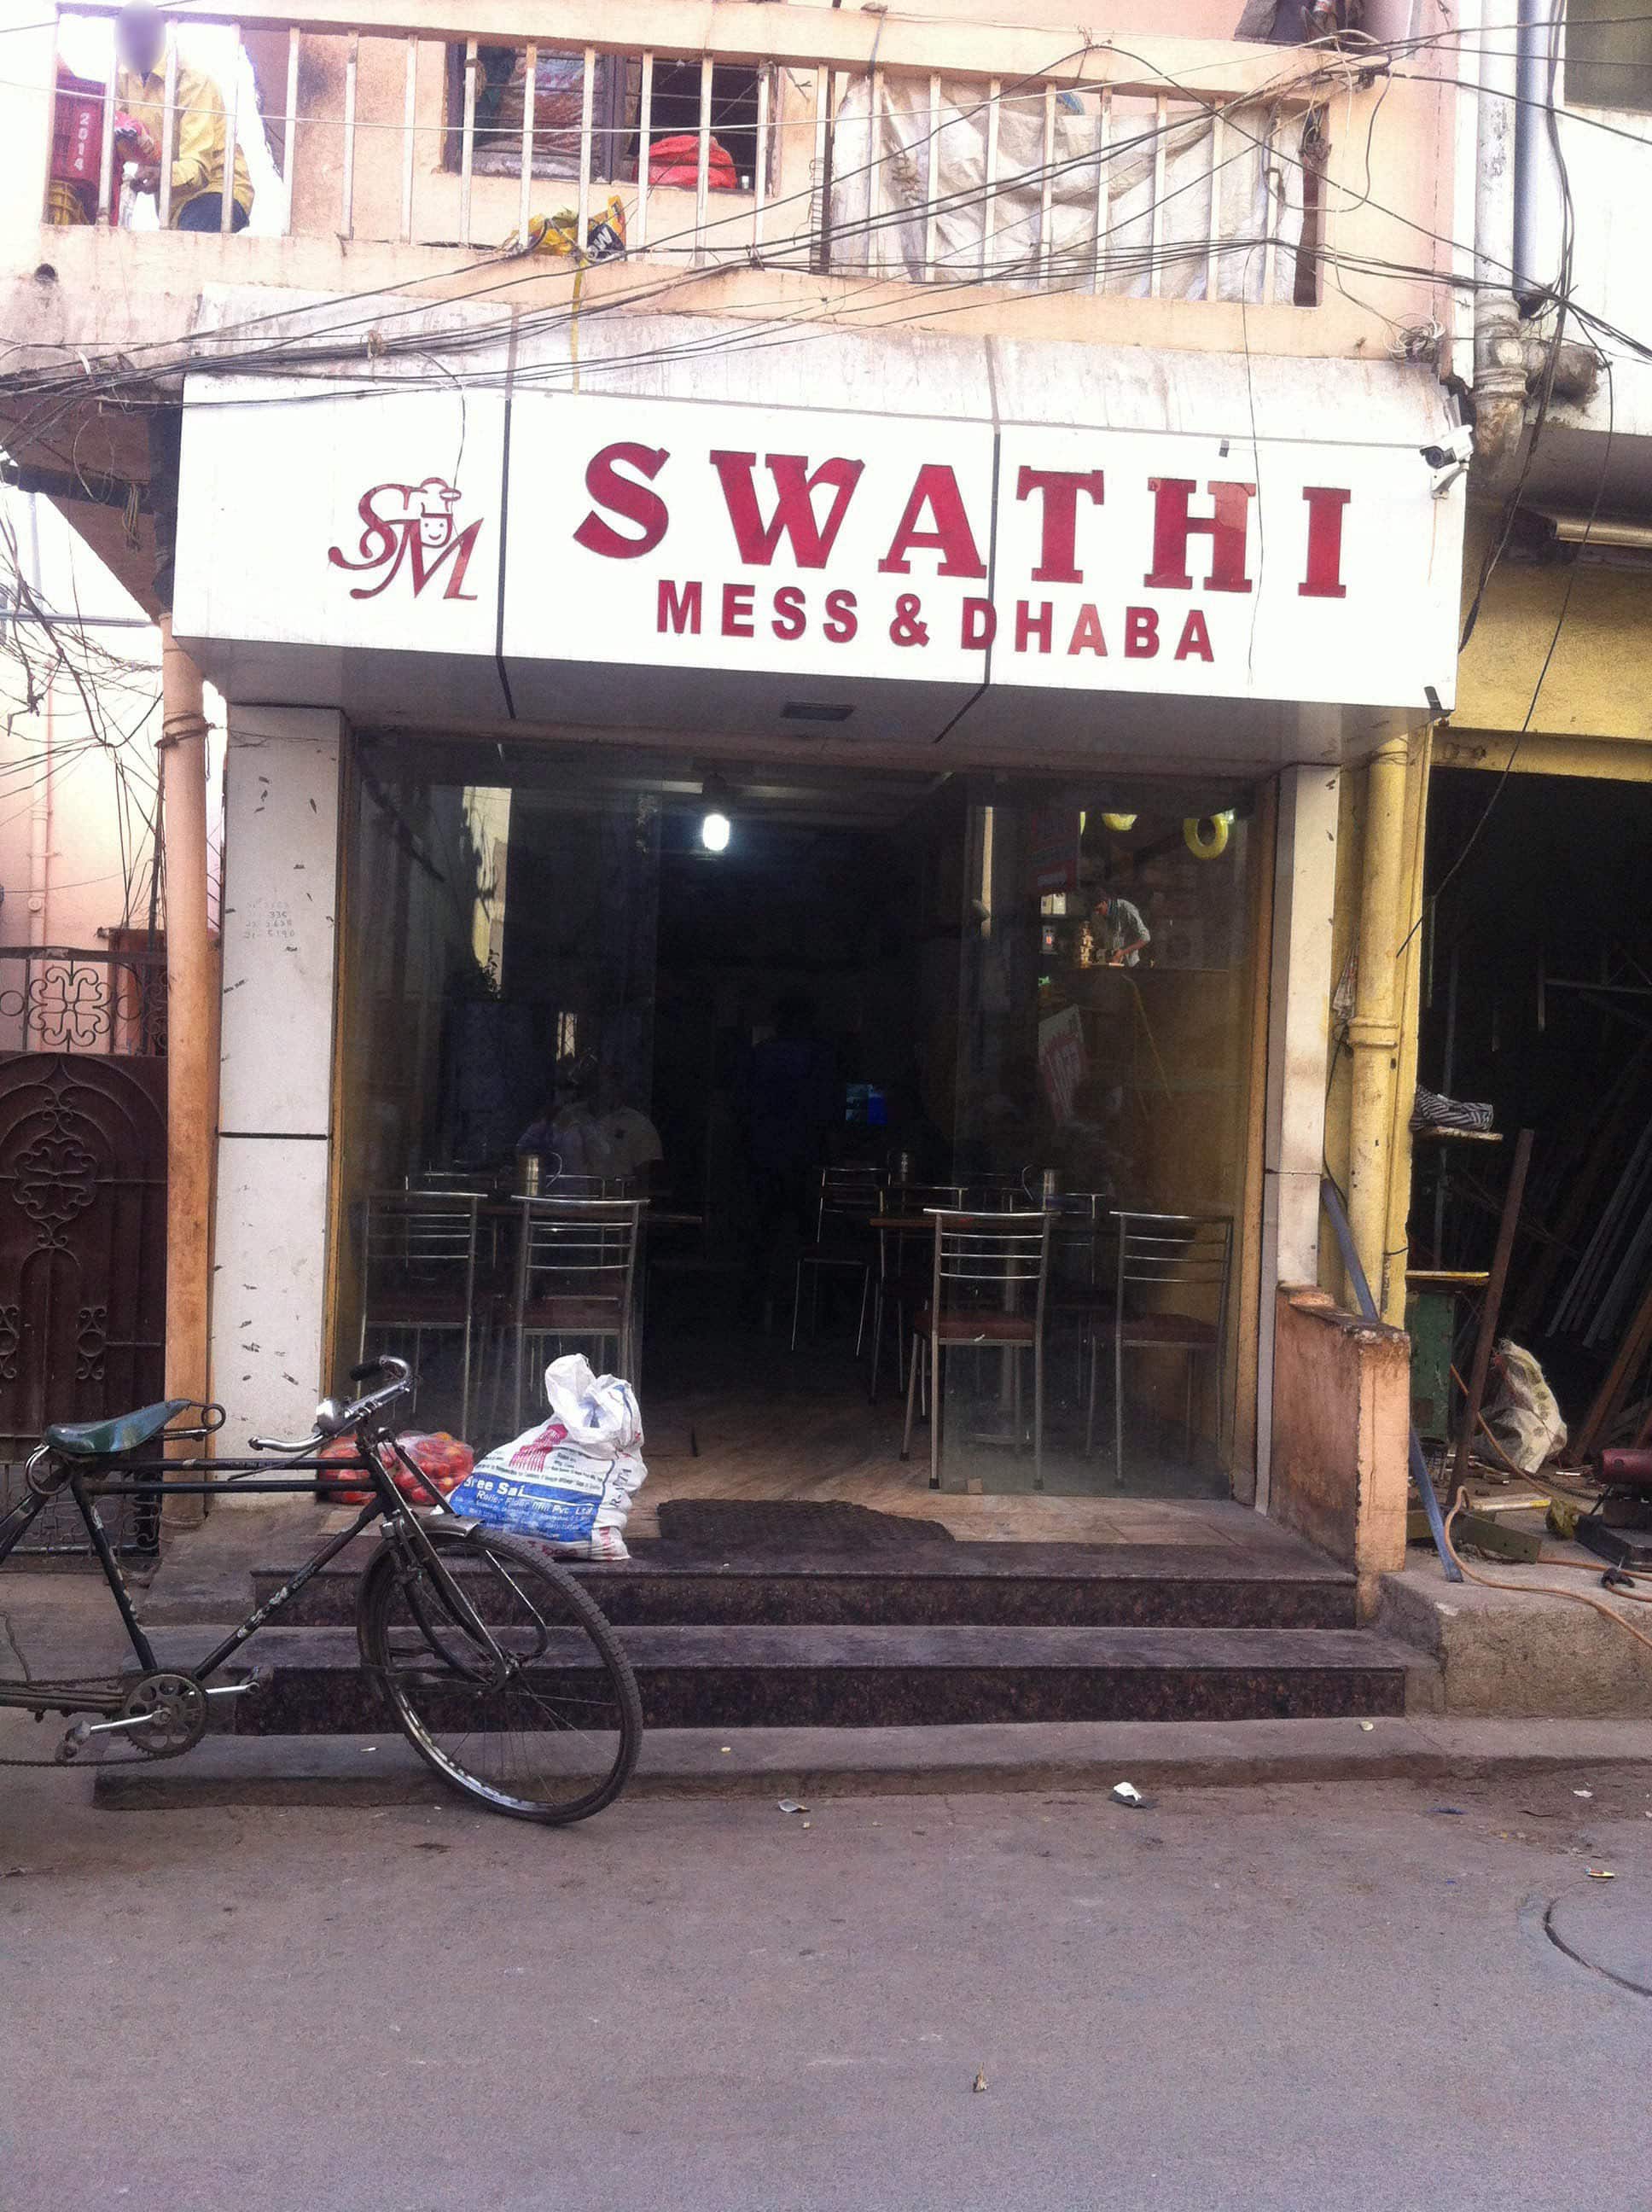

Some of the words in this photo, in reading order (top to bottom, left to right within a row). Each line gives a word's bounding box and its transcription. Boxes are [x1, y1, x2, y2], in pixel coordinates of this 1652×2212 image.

[74, 112, 90, 171] 2014
[573, 441, 1352, 599] SWATHI
[656, 580, 858, 645] MESS
[888, 593, 929, 647] &
[960, 597, 1214, 663] DHABA
